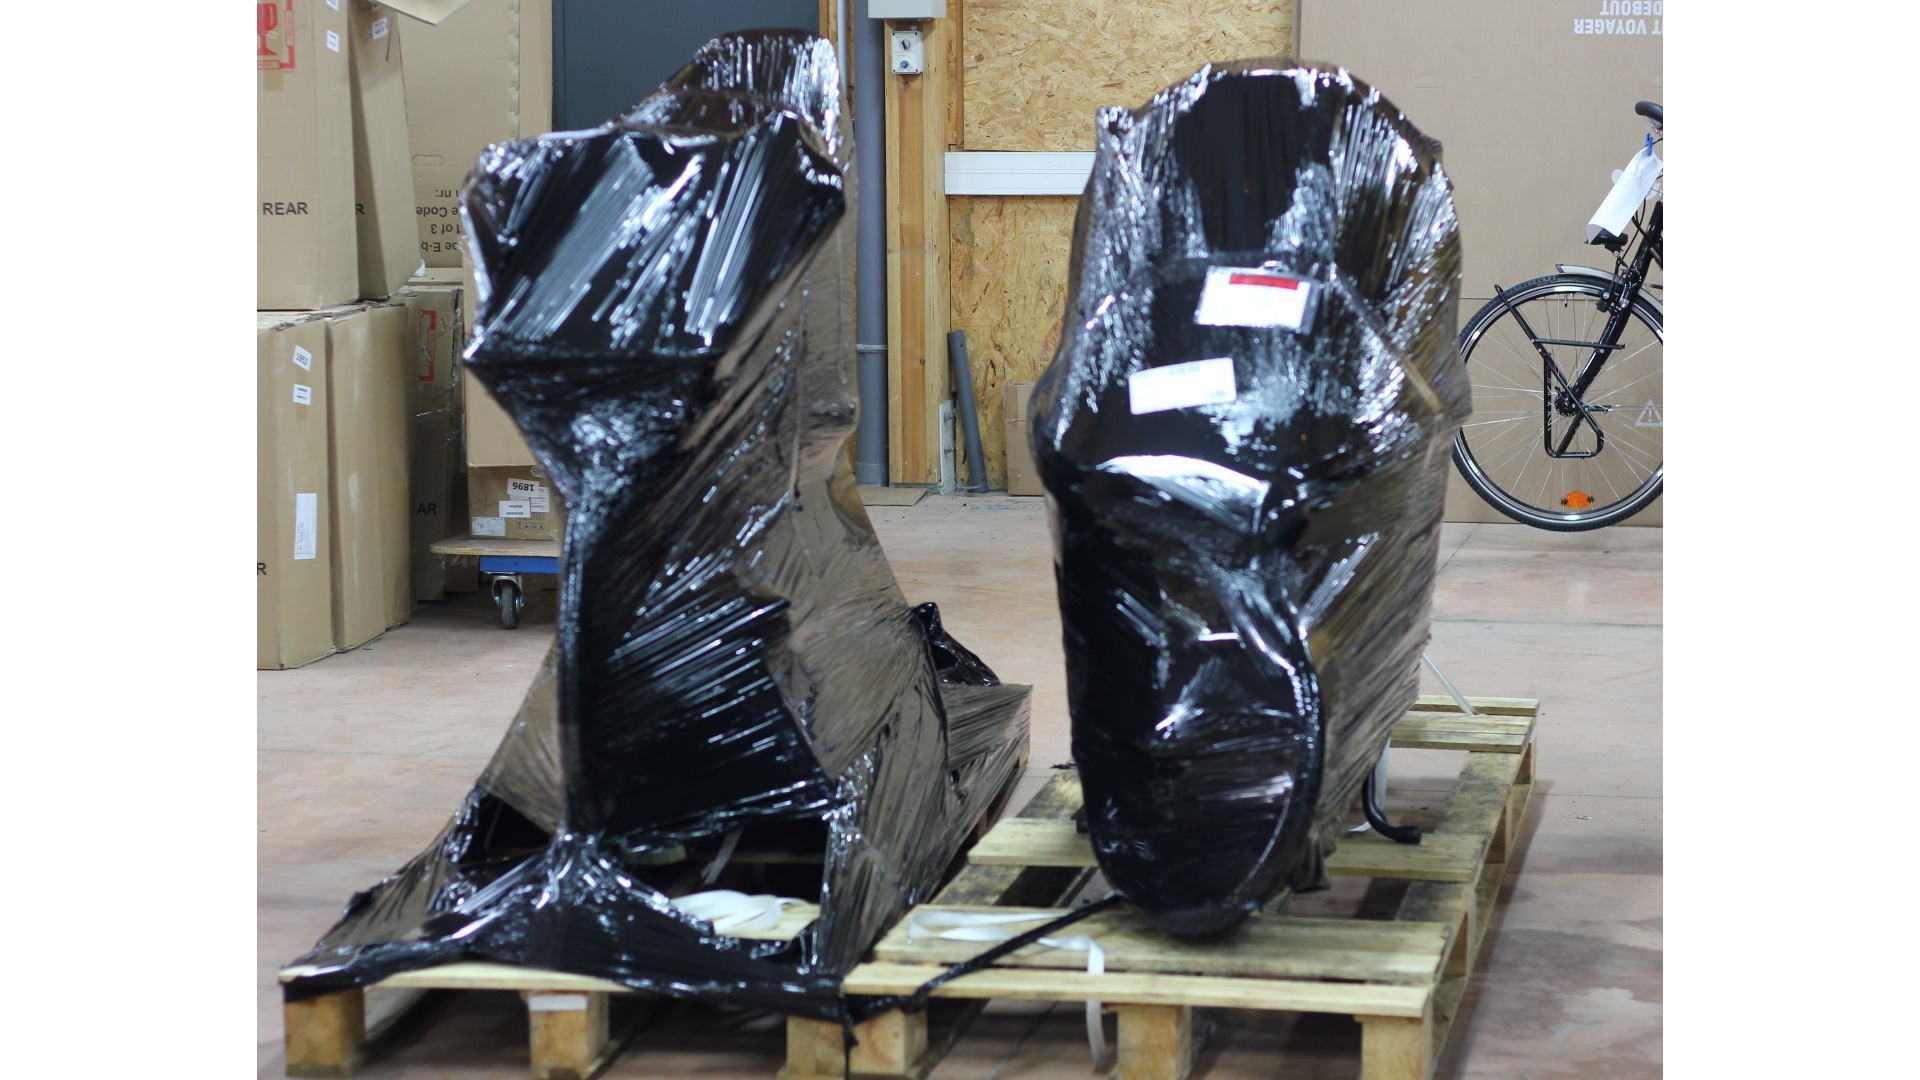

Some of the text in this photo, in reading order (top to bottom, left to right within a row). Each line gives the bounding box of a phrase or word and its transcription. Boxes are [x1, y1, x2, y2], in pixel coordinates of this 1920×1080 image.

[1600, 0, 1663, 15] DEBOUT
[1574, 19, 1647, 34] VOYAGER
[262, 202, 308, 215] REAR
[416, 206, 448, 218] Code
[430, 223, 438, 234] 3
[441, 224, 453, 234] of
[421, 241, 441, 252] E-b
[512, 482, 535, 491] 1896
[416, 503, 438, 515] AR
